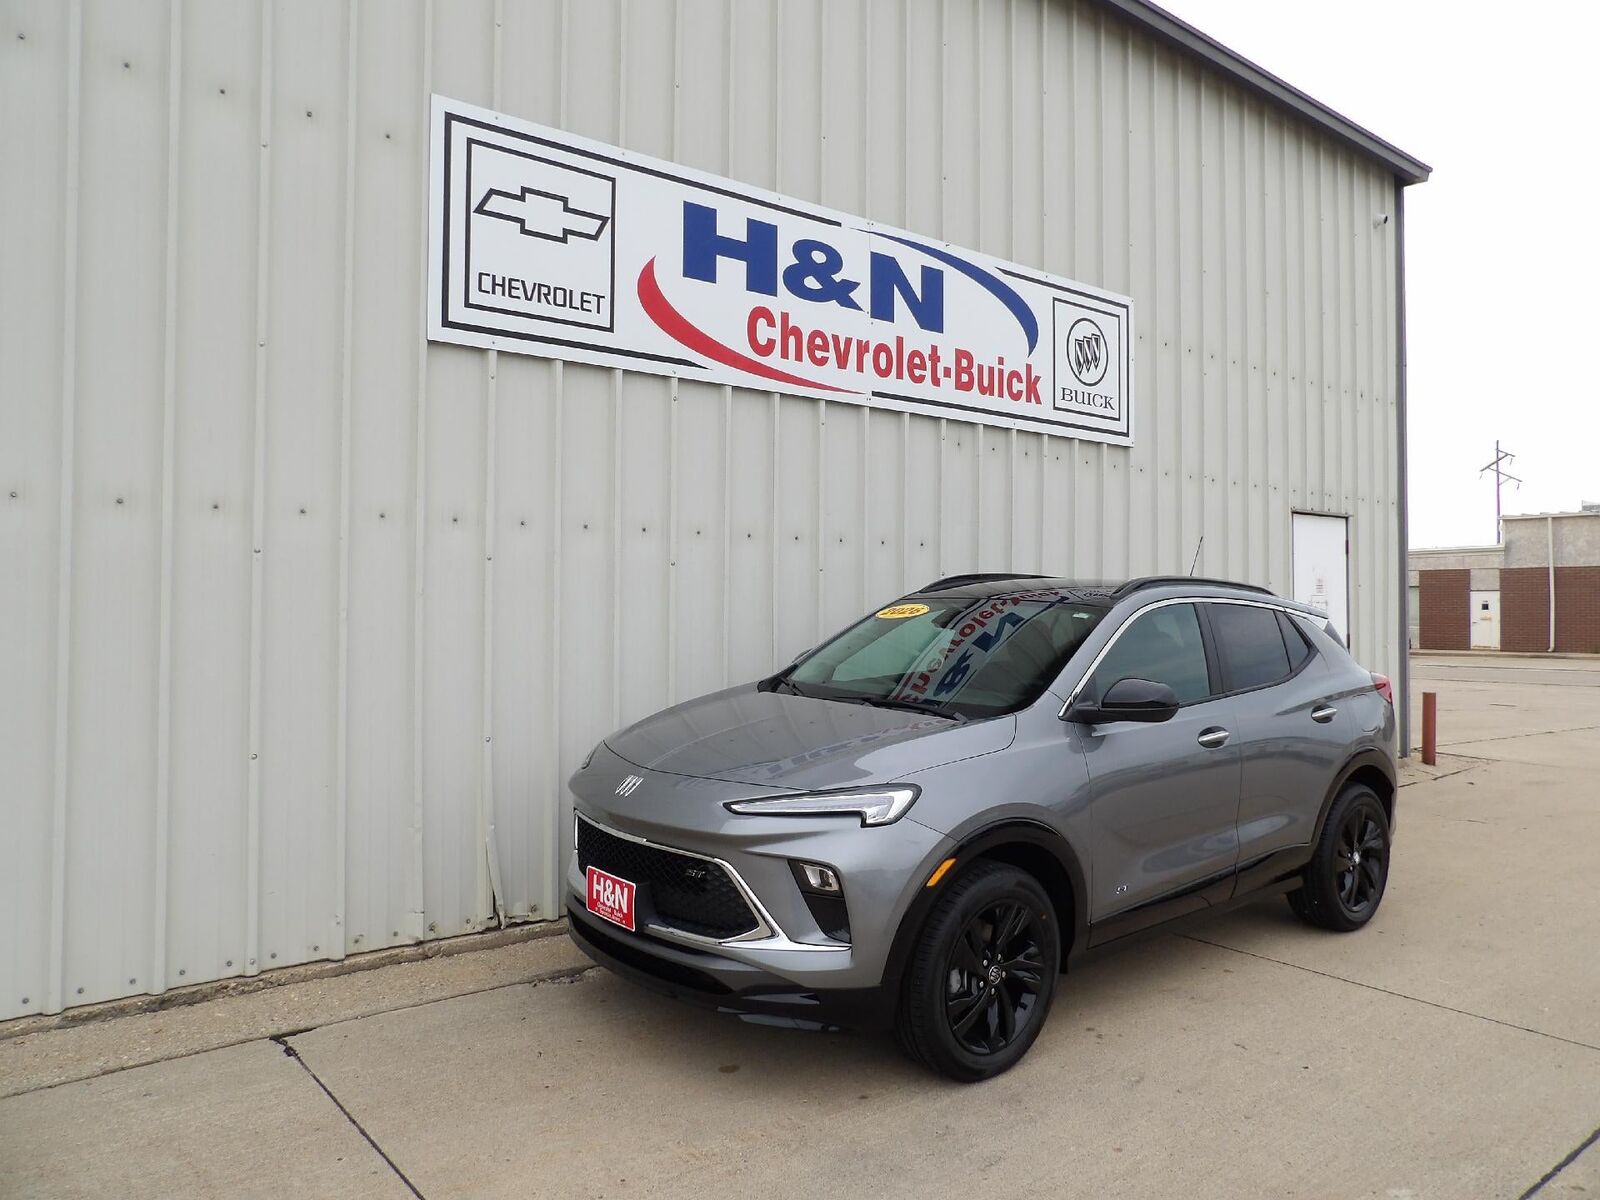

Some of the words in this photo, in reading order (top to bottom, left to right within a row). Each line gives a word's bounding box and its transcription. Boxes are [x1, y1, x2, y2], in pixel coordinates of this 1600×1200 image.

[682, 200, 944, 334] H&N
[477, 272, 606, 315] CHEVROLET
[747, 305, 1043, 405] Chevrolet-Buick
[1061, 387, 1116, 411] BUICK
[592, 873, 629, 914] H&N
